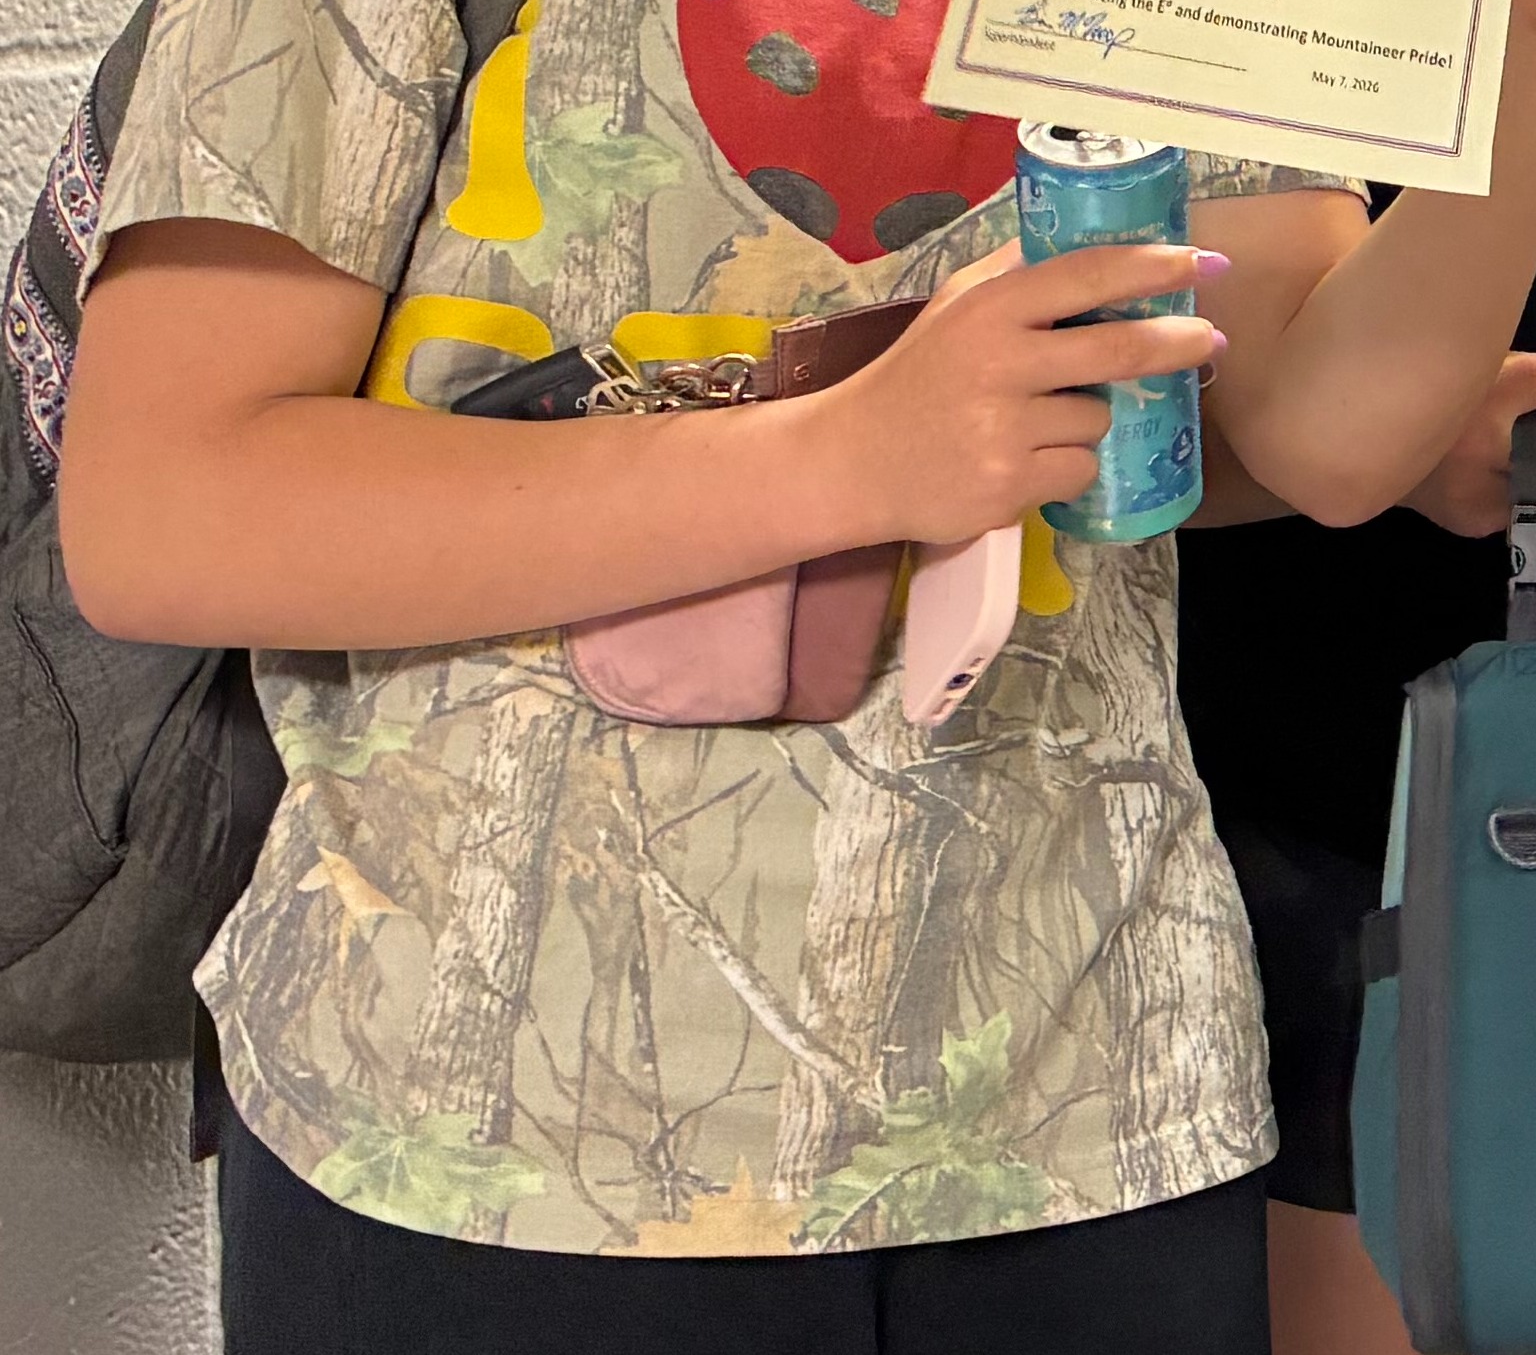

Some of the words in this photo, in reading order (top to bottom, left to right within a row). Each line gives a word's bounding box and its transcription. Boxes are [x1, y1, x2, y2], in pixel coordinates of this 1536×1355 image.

[1175, 6, 1200, 21] and
[1204, 9, 1308, 44] demonstrating
[1311, 30, 1406, 60] Mountaineer
[1409, 49, 1452, 69] Pride!
[1312, 71, 1336, 87] May
